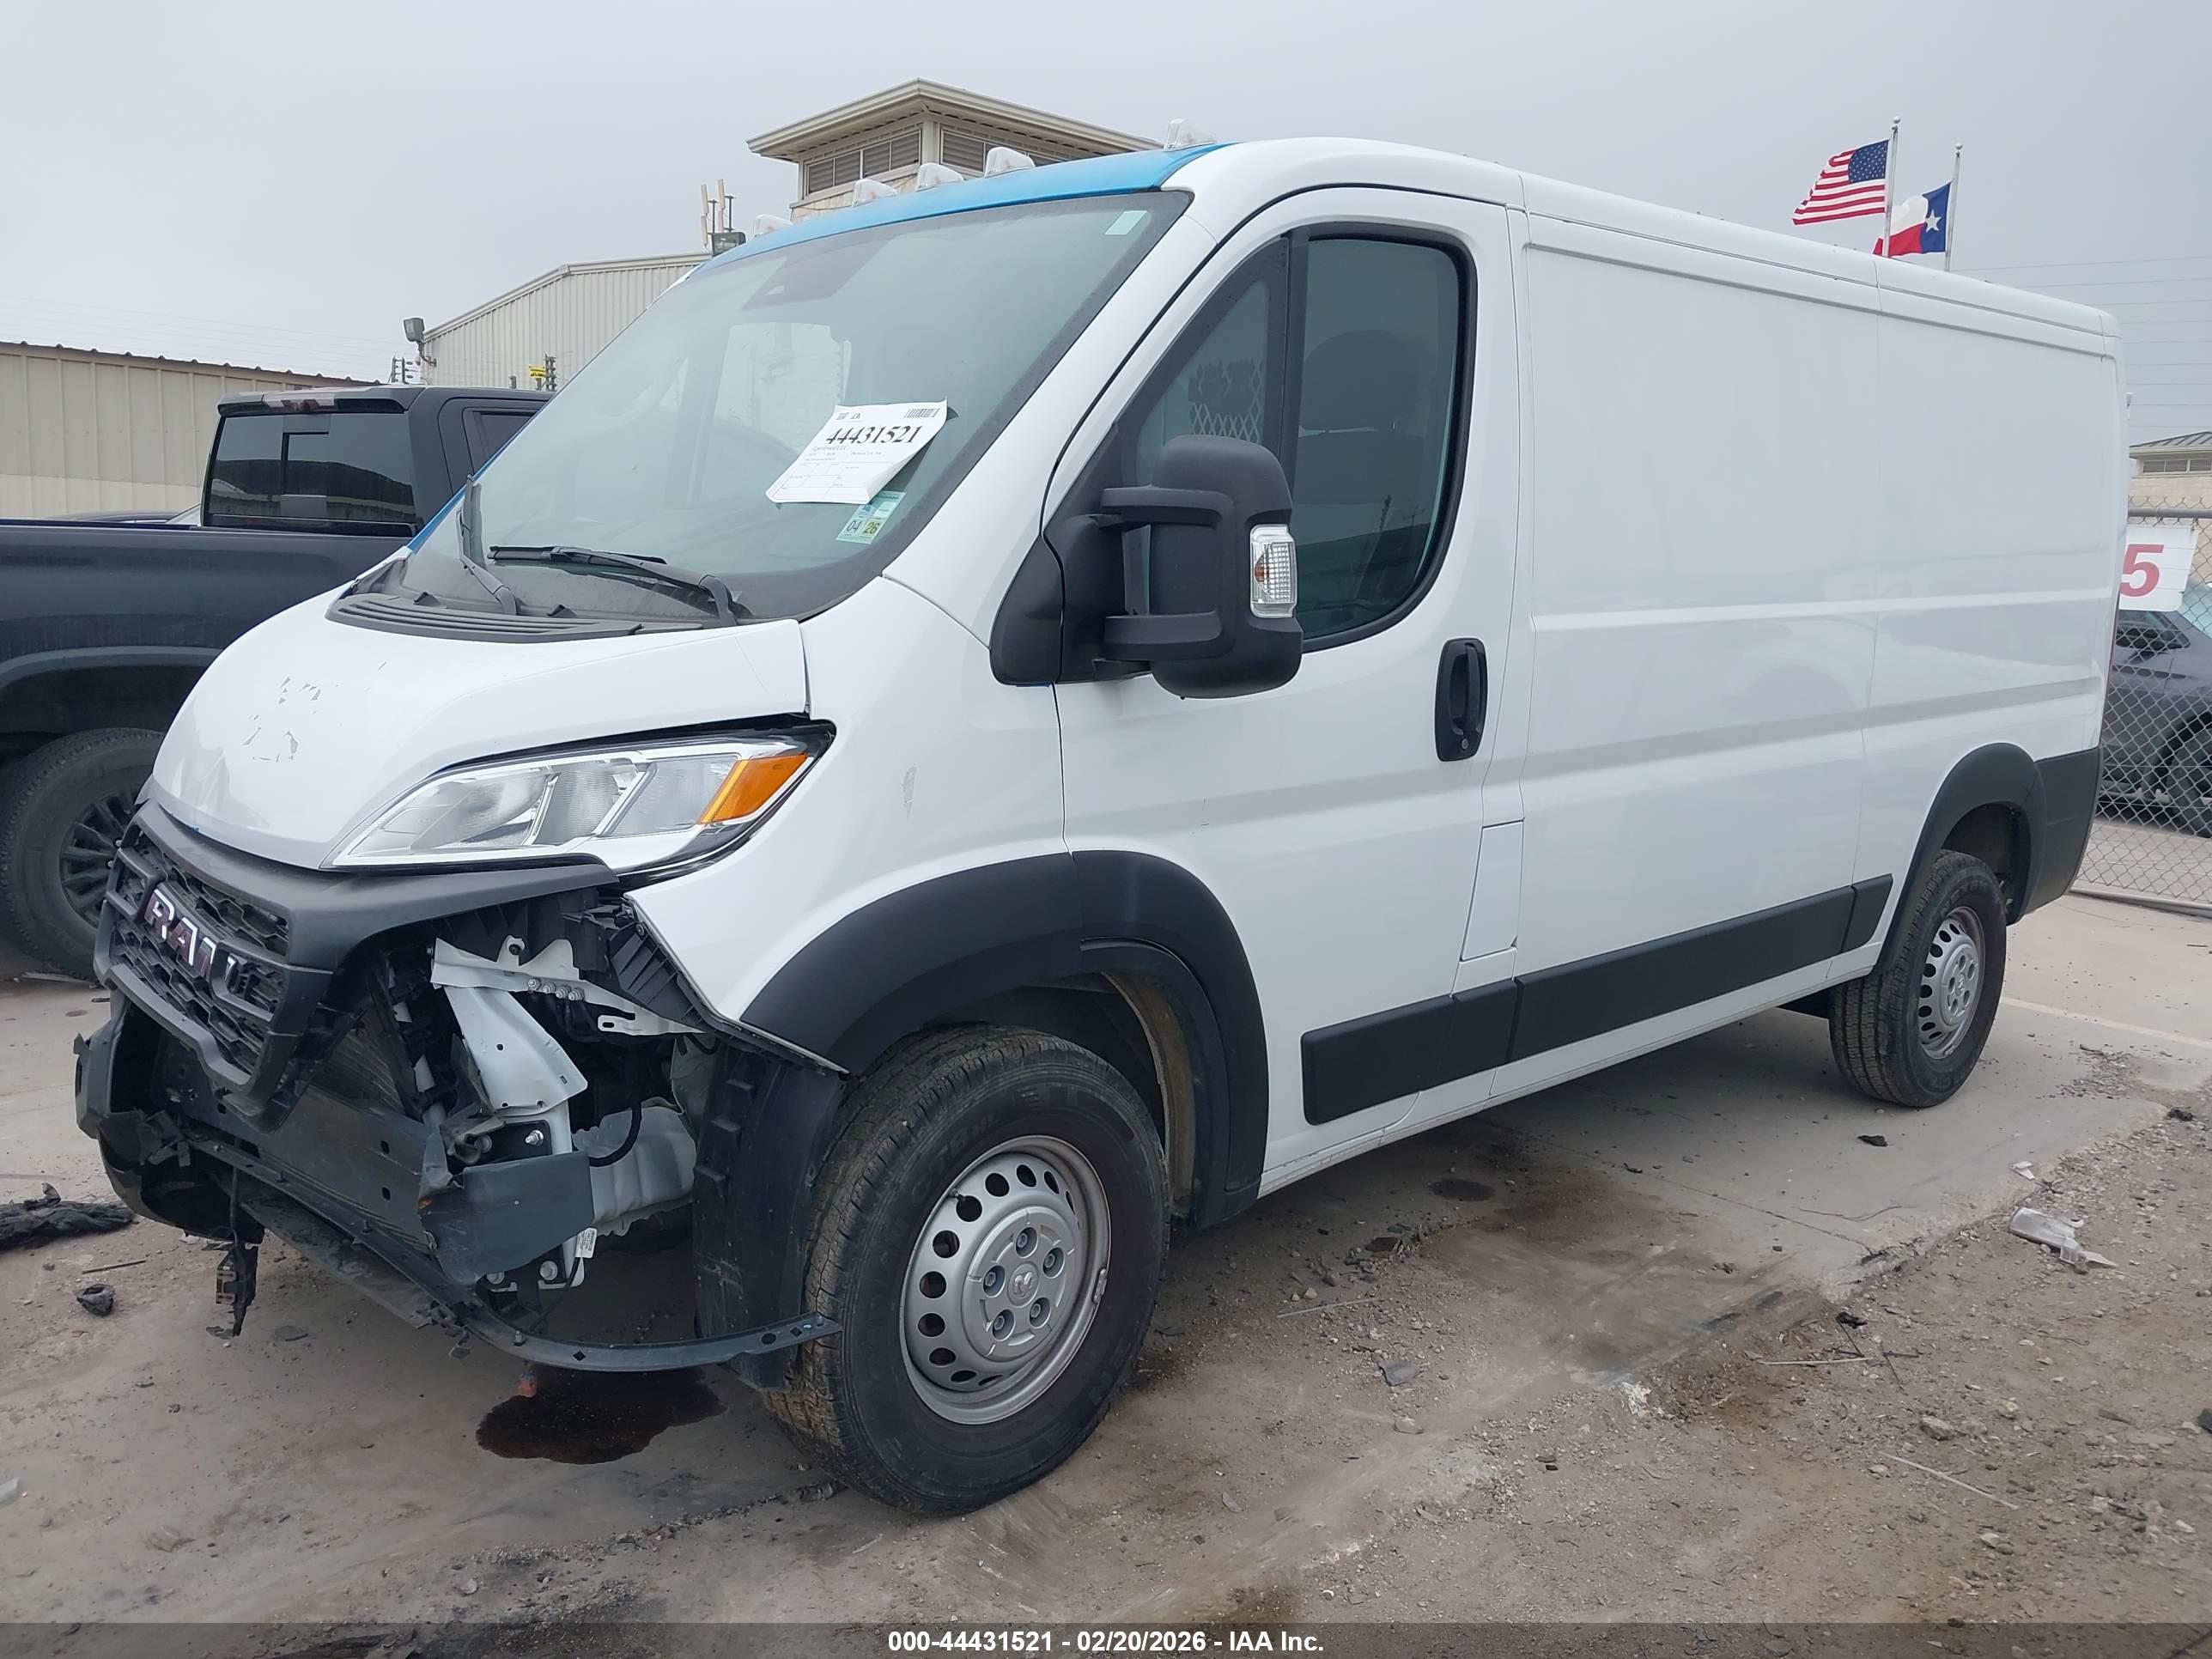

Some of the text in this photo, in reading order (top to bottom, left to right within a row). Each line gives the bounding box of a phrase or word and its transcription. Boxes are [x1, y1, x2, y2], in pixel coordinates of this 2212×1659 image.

[825, 426, 922, 444] 44431521
[846, 520, 880, 535] 04 26
